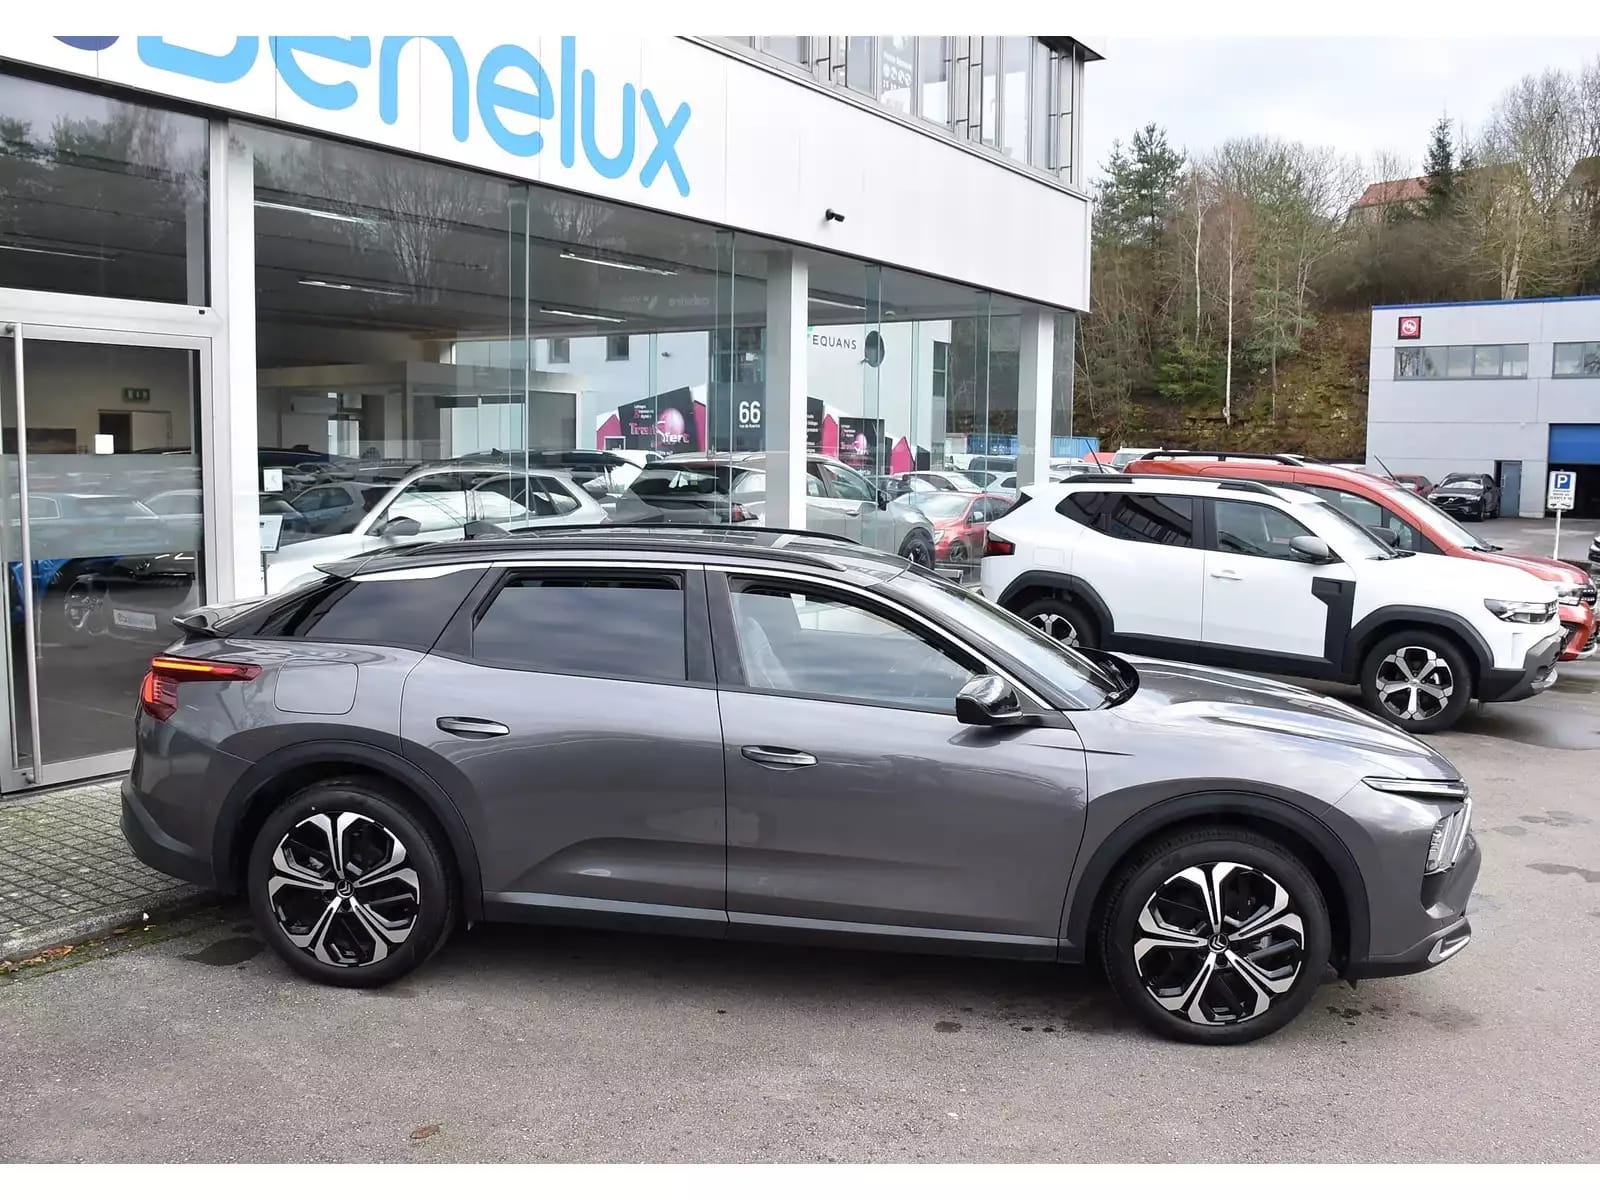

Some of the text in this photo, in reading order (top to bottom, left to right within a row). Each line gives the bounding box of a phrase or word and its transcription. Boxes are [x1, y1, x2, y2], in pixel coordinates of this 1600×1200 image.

[138, 36, 690, 196] enelux
[812, 334, 857, 350] EQUANS
[739, 400, 761, 424] 66
[1557, 474, 1568, 489] P
